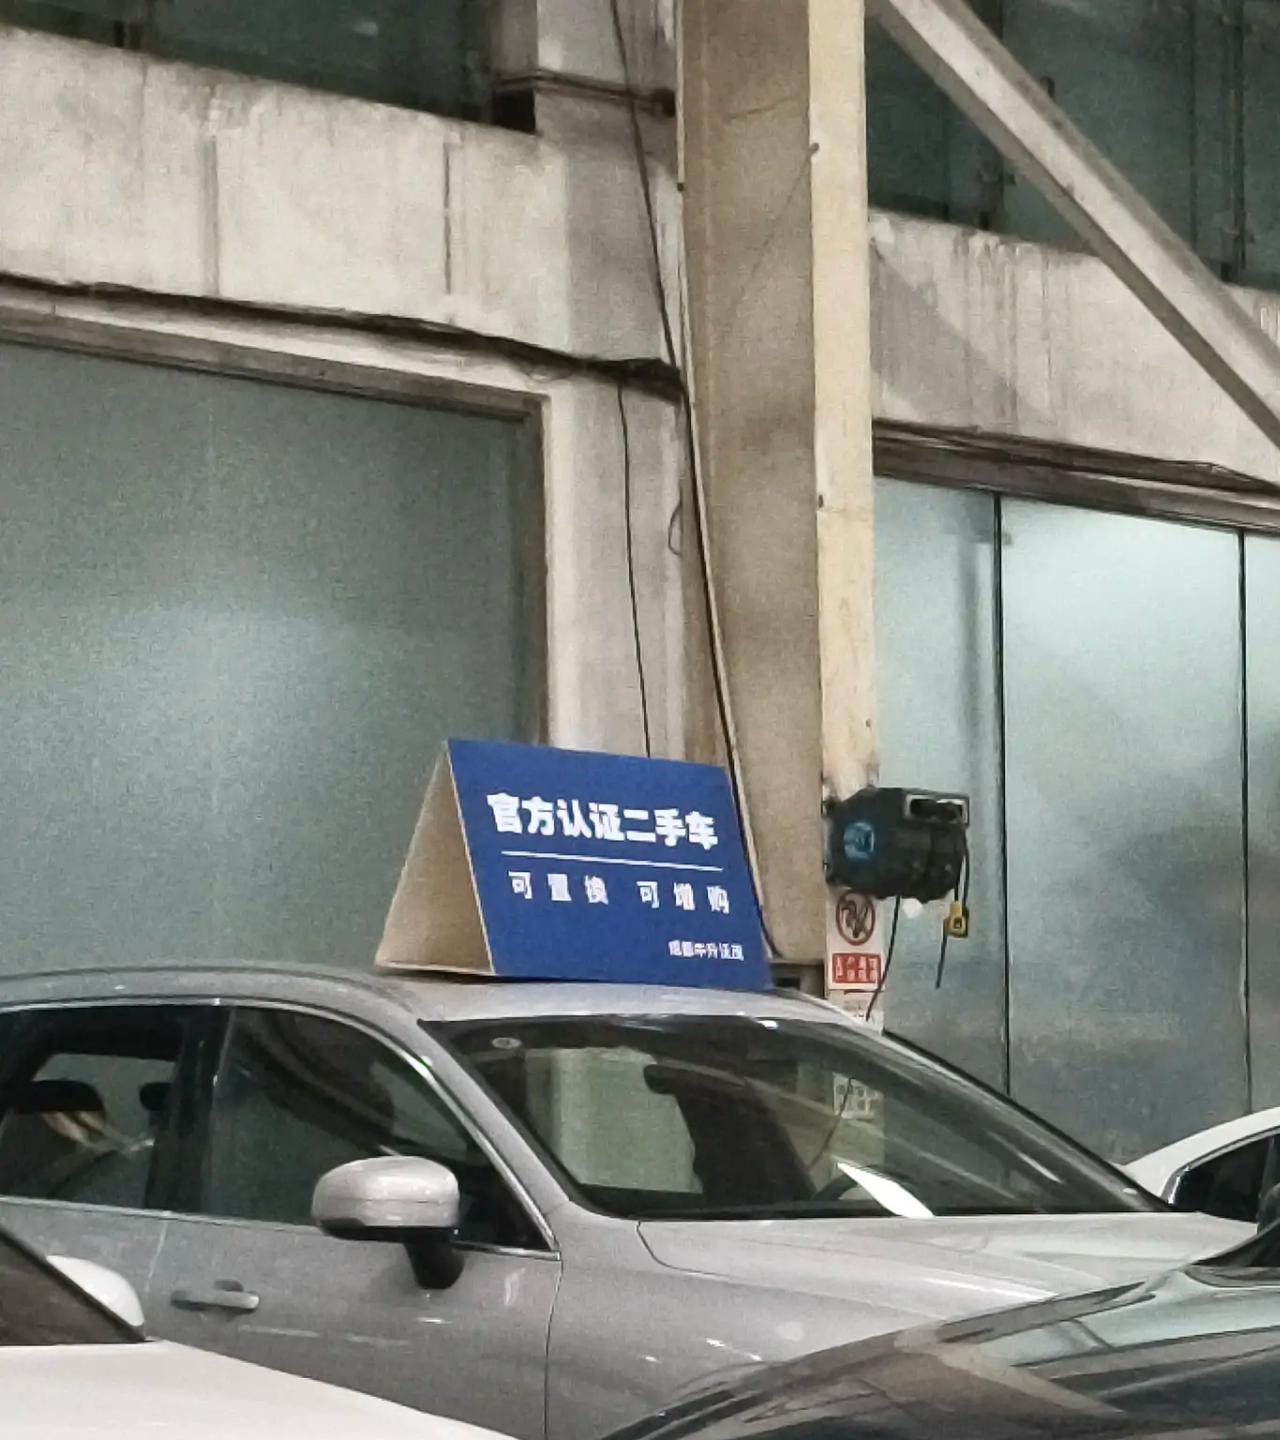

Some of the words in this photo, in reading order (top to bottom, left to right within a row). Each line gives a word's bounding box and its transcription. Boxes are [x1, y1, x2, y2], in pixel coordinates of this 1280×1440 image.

[486, 792, 718, 850] 官方认证二手车
